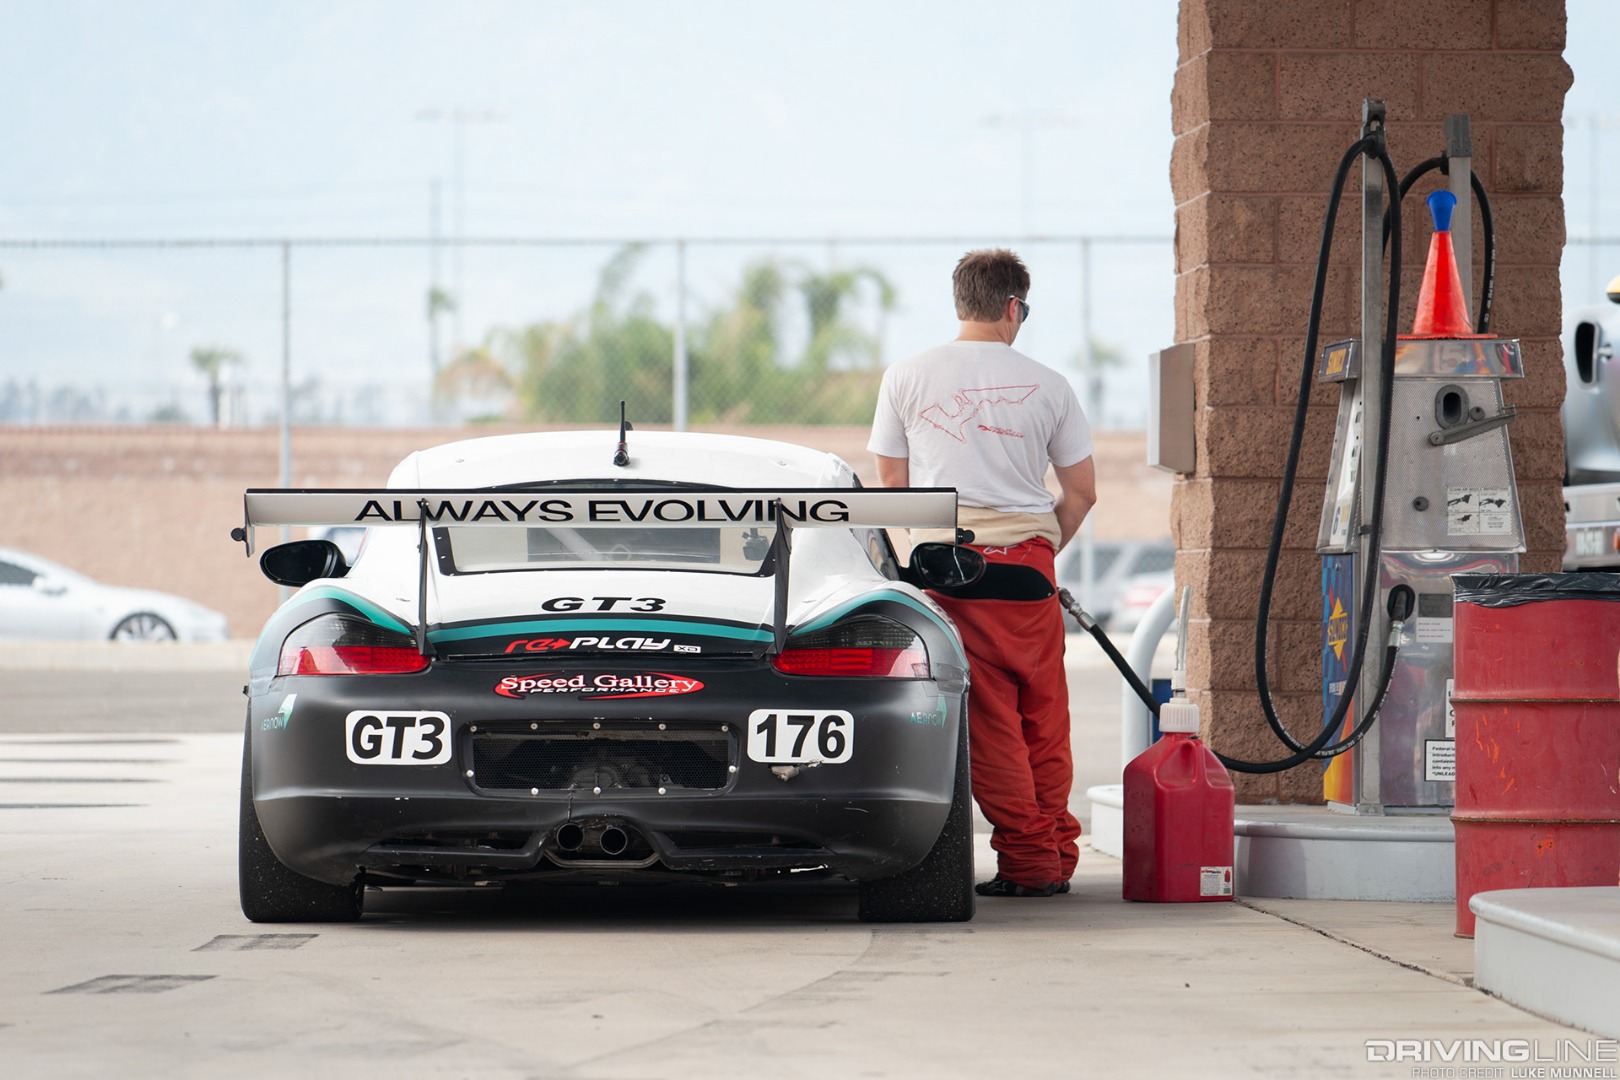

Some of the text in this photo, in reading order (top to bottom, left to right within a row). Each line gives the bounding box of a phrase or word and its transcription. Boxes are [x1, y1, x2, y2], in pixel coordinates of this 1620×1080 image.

[354, 499, 850, 522] ALWAYS EVOLVING
[541, 597, 667, 612] GT3
[501, 674, 698, 693] Speed Gallery
[529, 686, 682, 694] PERFORMANCE
[351, 715, 446, 760] GT3
[755, 713, 847, 759] 176
